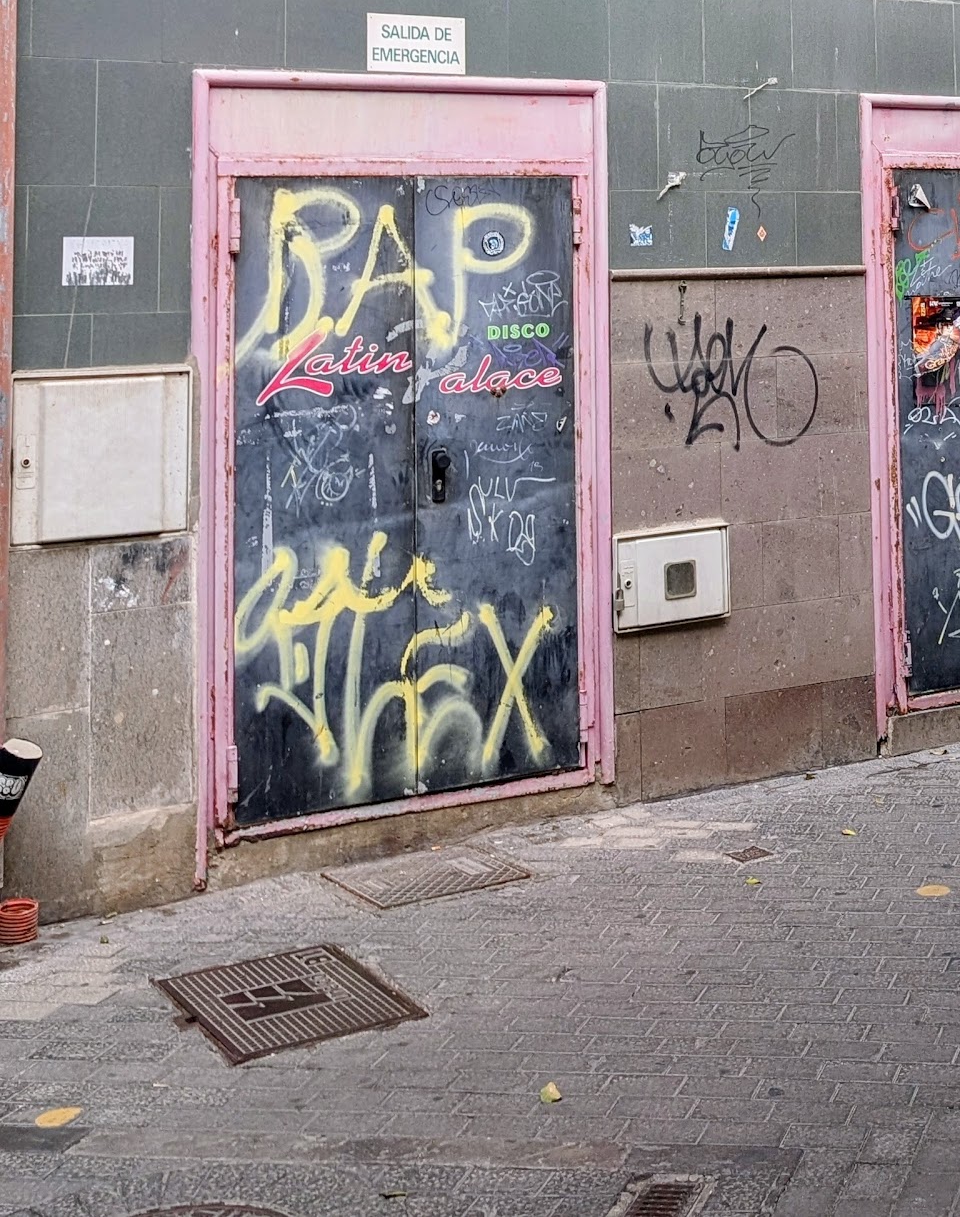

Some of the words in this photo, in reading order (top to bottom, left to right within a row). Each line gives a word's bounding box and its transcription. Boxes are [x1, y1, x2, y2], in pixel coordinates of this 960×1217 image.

[381, 24, 430, 40] SALIDA
[434, 27, 452, 42] DE
[372, 47, 460, 65] EMERGENCIA
[487, 322, 551, 340] DISCO
[256, 328, 413, 406] Latin
